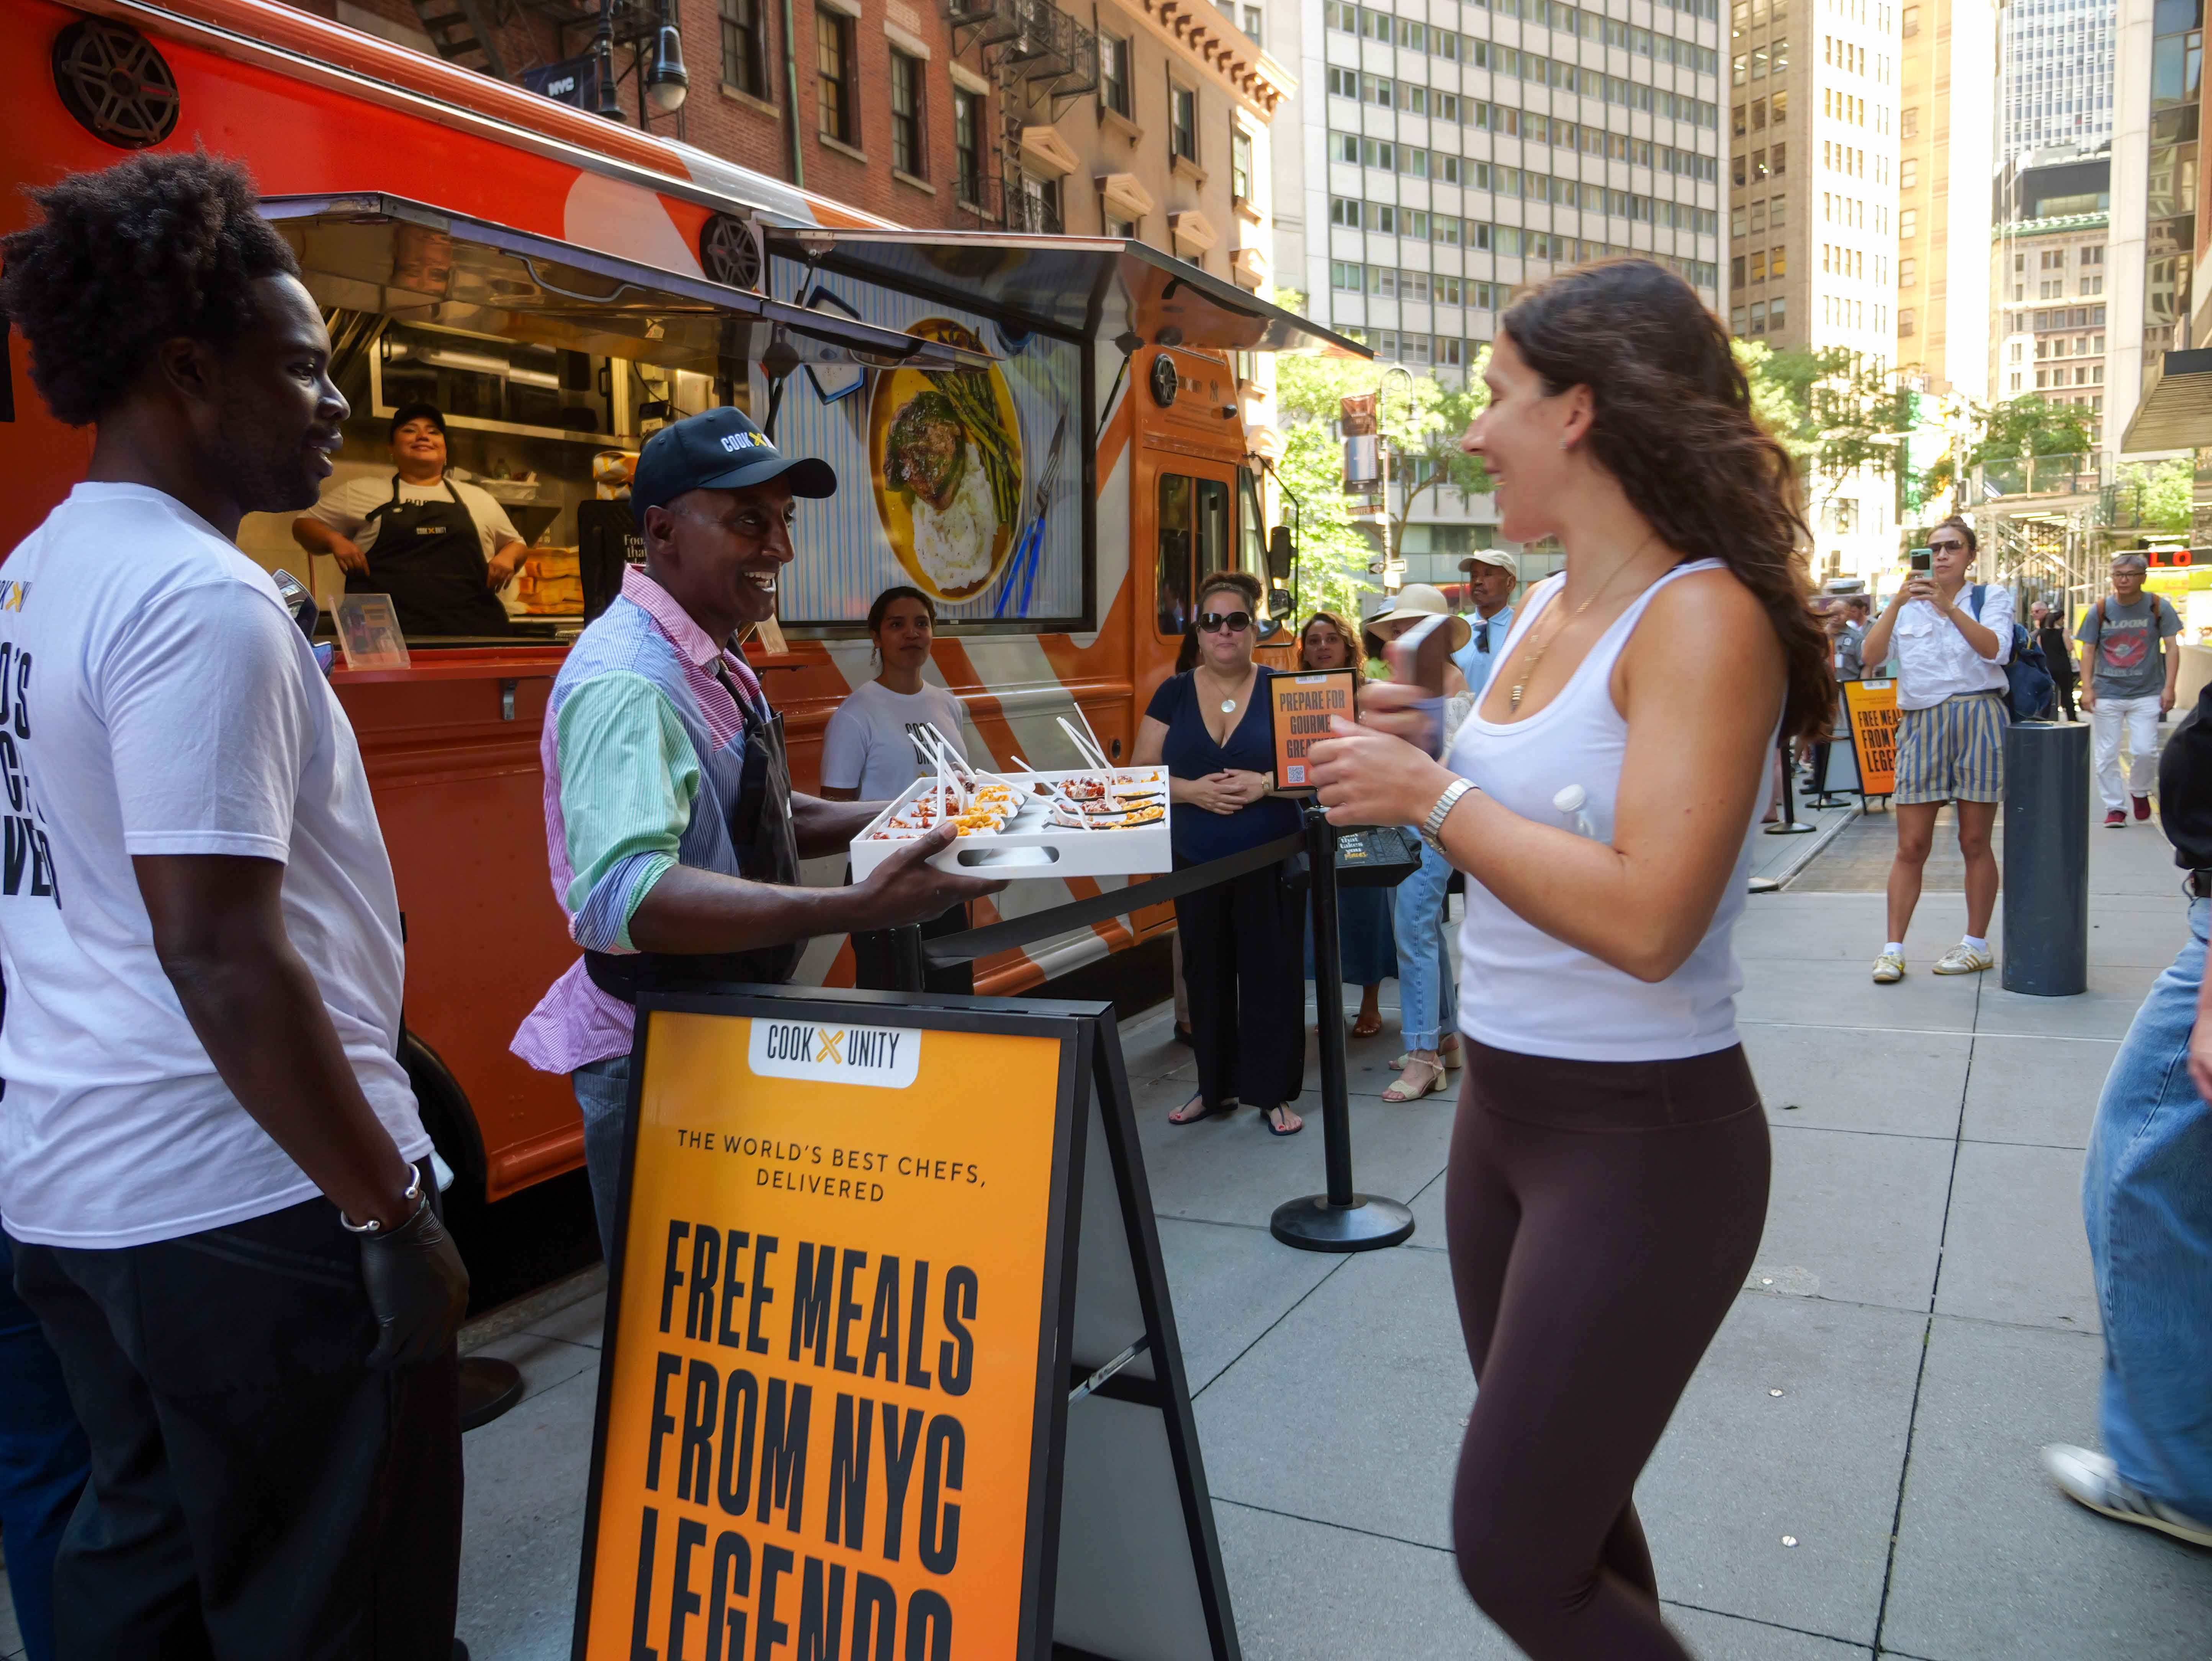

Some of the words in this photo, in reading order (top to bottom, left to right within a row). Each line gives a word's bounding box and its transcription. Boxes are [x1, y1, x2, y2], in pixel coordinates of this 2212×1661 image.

[548, 77, 574, 97] NYC
[720, 432, 755, 452] COOK
[624, 534, 644, 545] Foo
[1279, 691, 1324, 712] PREPARE
[1326, 690, 1345, 709] FOR
[1290, 714, 1332, 735] GOURME
[1858, 710, 1879, 727] FREE
[1862, 728, 1891, 749] FROM
[767, 1024, 815, 1062] COOK
[848, 1030, 900, 1068] UNITY
[678, 1129, 715, 1150] THE
[724, 1135, 821, 1164] WORLD'S
[833, 1148, 888, 1172] BEST
[898, 1156, 986, 1188] CHEFS,
[757, 1168, 884, 1202] DELIVERED
[659, 1219, 778, 1355] FREE
[788, 1240, 979, 1397] MEALS
[645, 1351, 814, 1533] FROM
[825, 1392, 965, 1575] NYC
